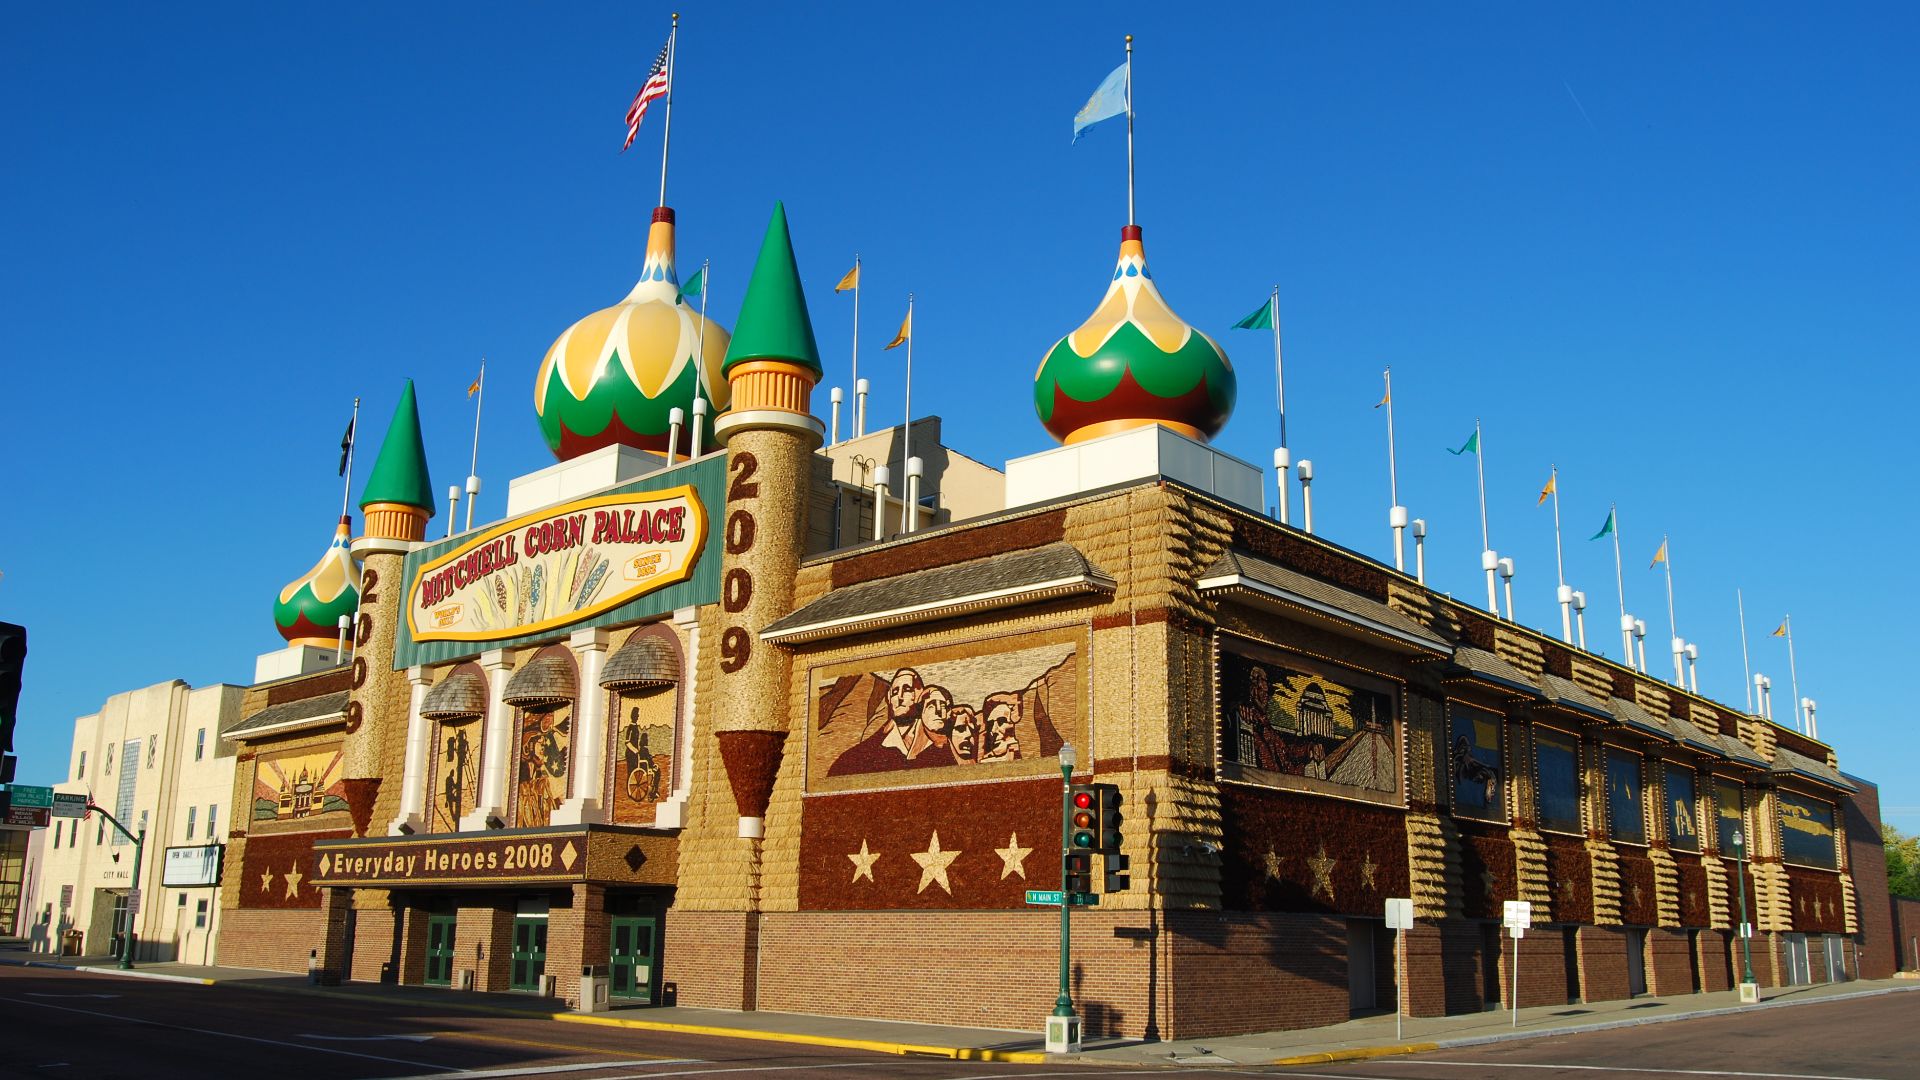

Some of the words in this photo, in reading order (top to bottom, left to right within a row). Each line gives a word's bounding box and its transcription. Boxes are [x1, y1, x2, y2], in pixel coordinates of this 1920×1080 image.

[421, 534, 518, 609] MITCHELL
[524, 513, 587, 558] CORN
[592, 506, 686, 544] PALACE
[633, 553, 661, 568] SINCE
[720, 451, 759, 674] 2009
[637, 564, 657, 578] 1892
[346, 568, 378, 735] 2009
[55, 794, 85, 802] PARKING
[333, 851, 416, 877] Everyday
[424, 849, 497, 871] Heroes
[503, 844, 552, 869] 2008
[103, 871, 114, 879] CITY
[1039, 893, 1051, 901] MAIN
[1054, 894, 1060, 902] ST
